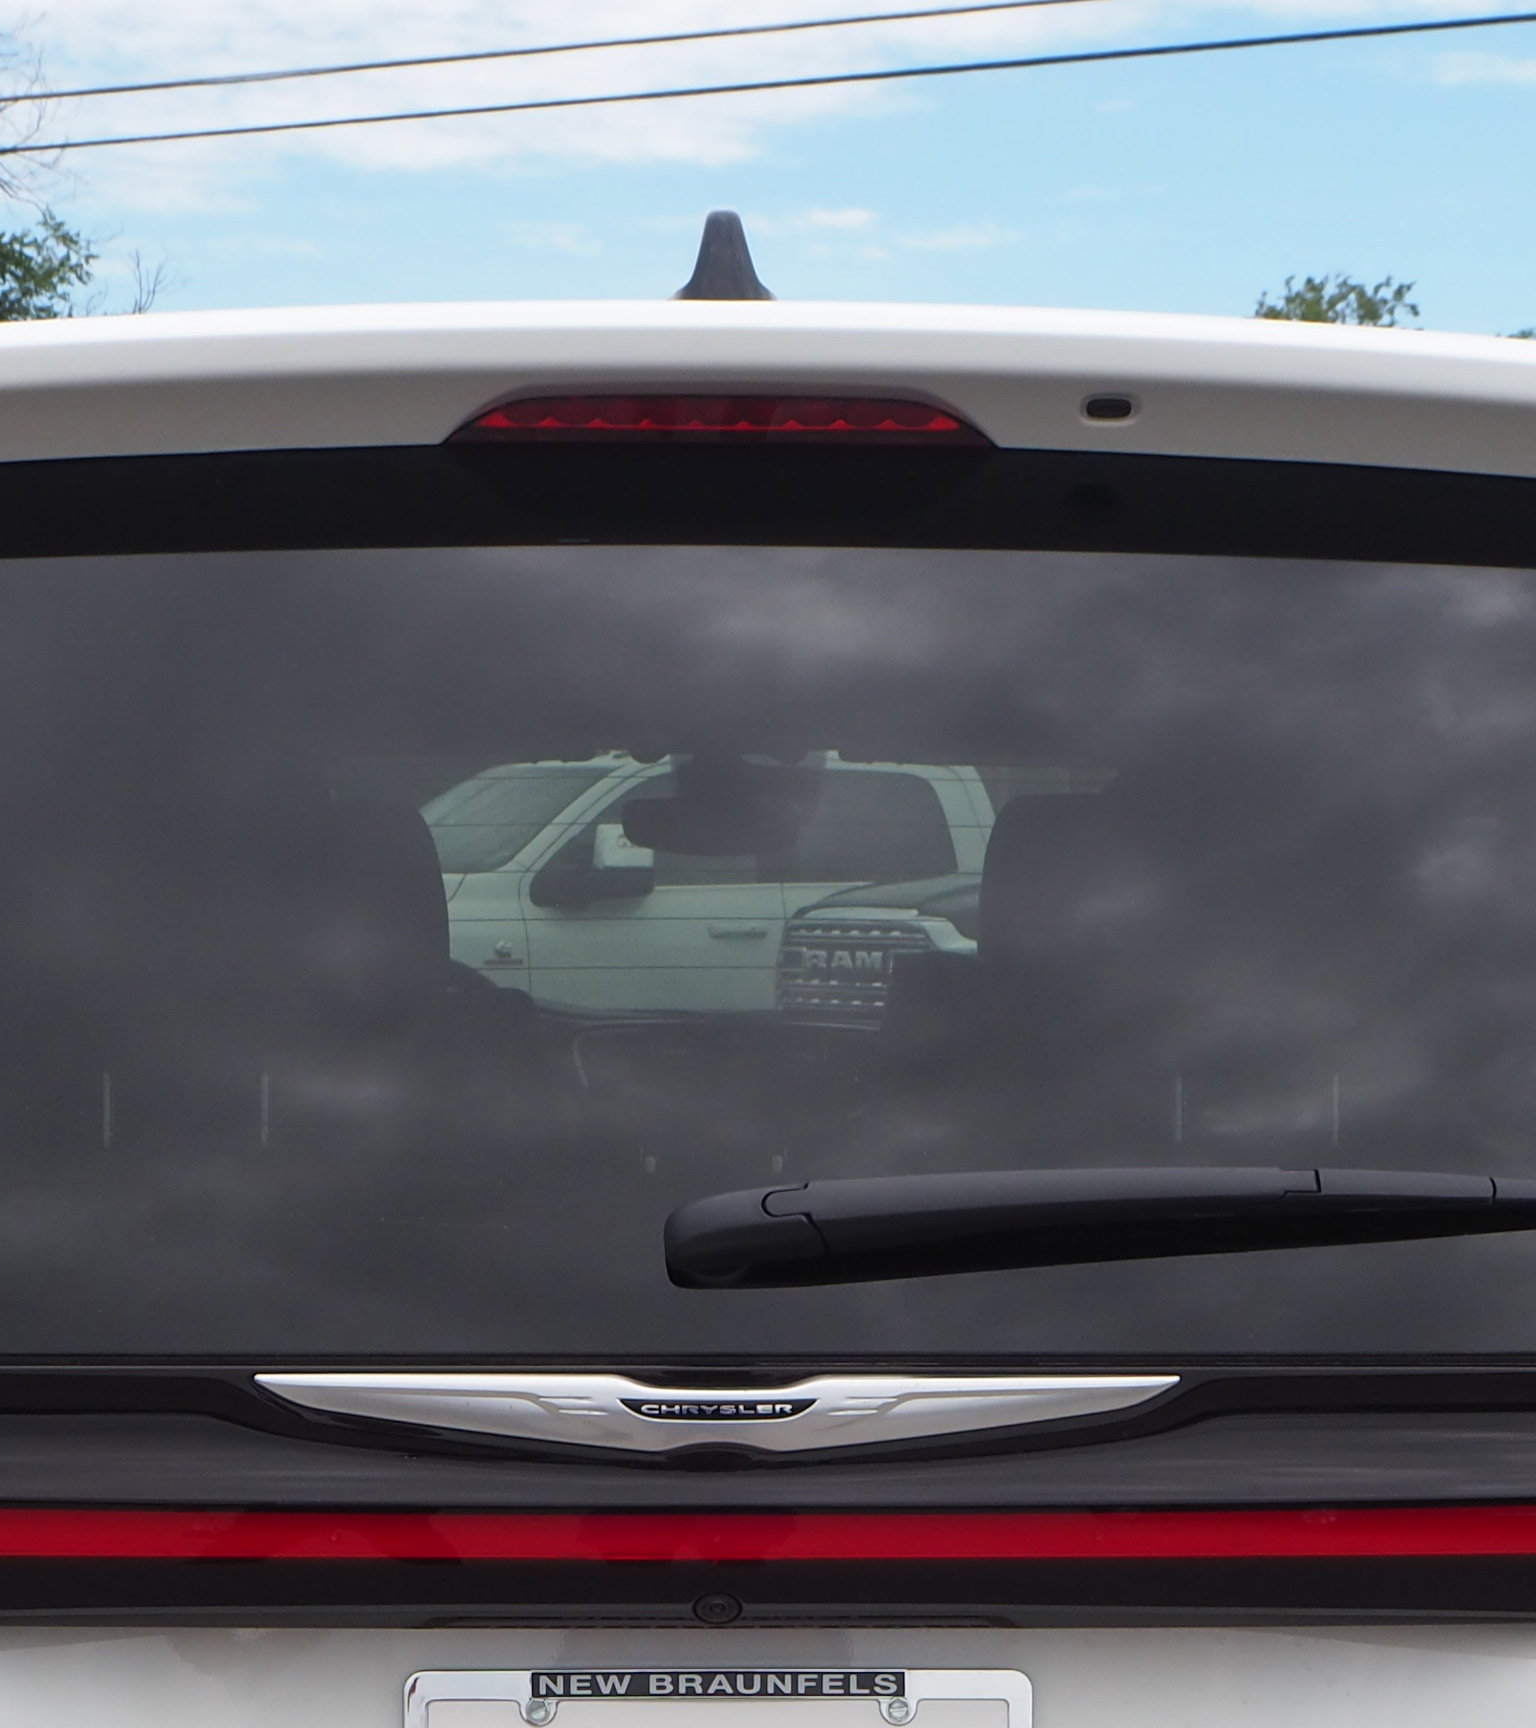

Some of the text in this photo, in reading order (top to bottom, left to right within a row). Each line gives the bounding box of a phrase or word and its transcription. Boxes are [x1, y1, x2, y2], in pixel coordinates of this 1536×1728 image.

[804, 951, 883, 969] RAM
[641, 1404, 793, 1415] CHRYSLER
[539, 1674, 898, 1695] NEW BRAUNFELS
